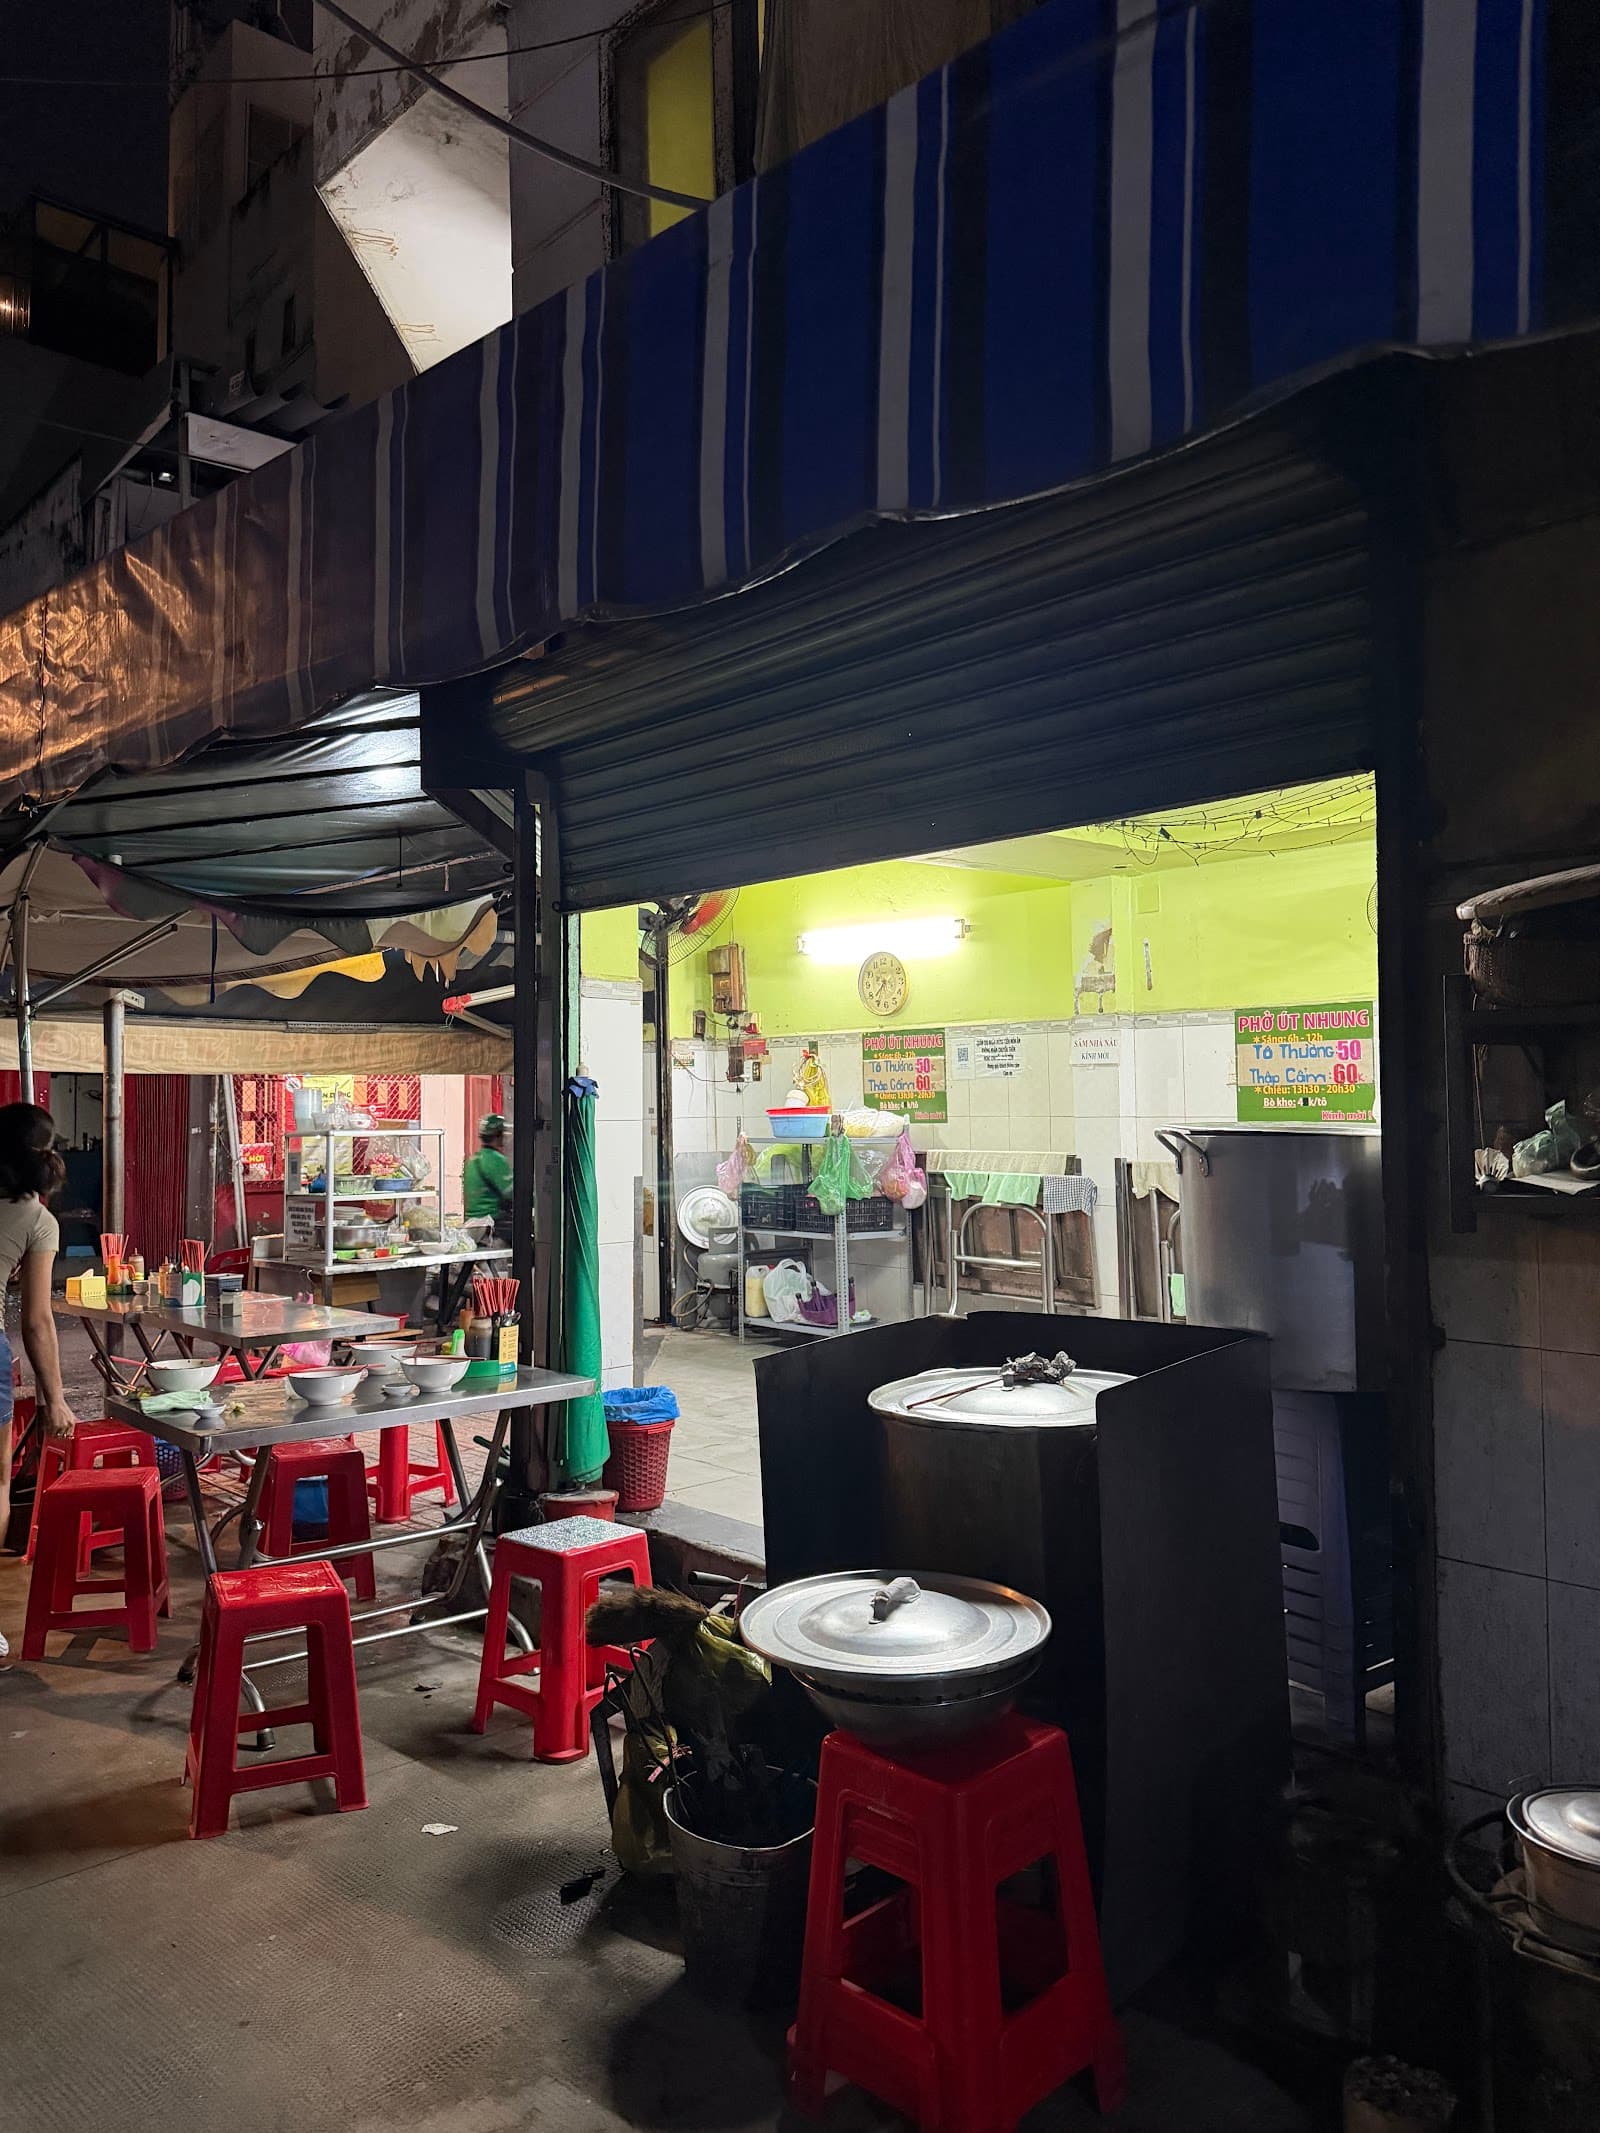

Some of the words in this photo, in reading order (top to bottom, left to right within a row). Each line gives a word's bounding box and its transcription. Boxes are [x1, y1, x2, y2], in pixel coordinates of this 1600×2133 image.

[884, 1001, 889, 1009] 6
[1238, 1010, 1273, 1032] PHỞ
[1277, 1010, 1299, 1030] ÚT
[1303, 1010, 1369, 1029] NHUNG
[904, 1034, 943, 1048] NHUNG
[1287, 1034, 1299, 1042] 6h
[1306, 1033, 1322, 1041] 12h
[1253, 1044, 1273, 1059] Tô
[1292, 1085, 1319, 1094] 13h30
[1327, 1084, 1355, 1093] 20h30
[1263, 1098, 1275, 1107] Bò
[1277, 1098, 1296, 1107] kho:
[1297, 1097, 1327, 1107] 4k/tô
[1322, 1110, 1344, 1120] Kính
